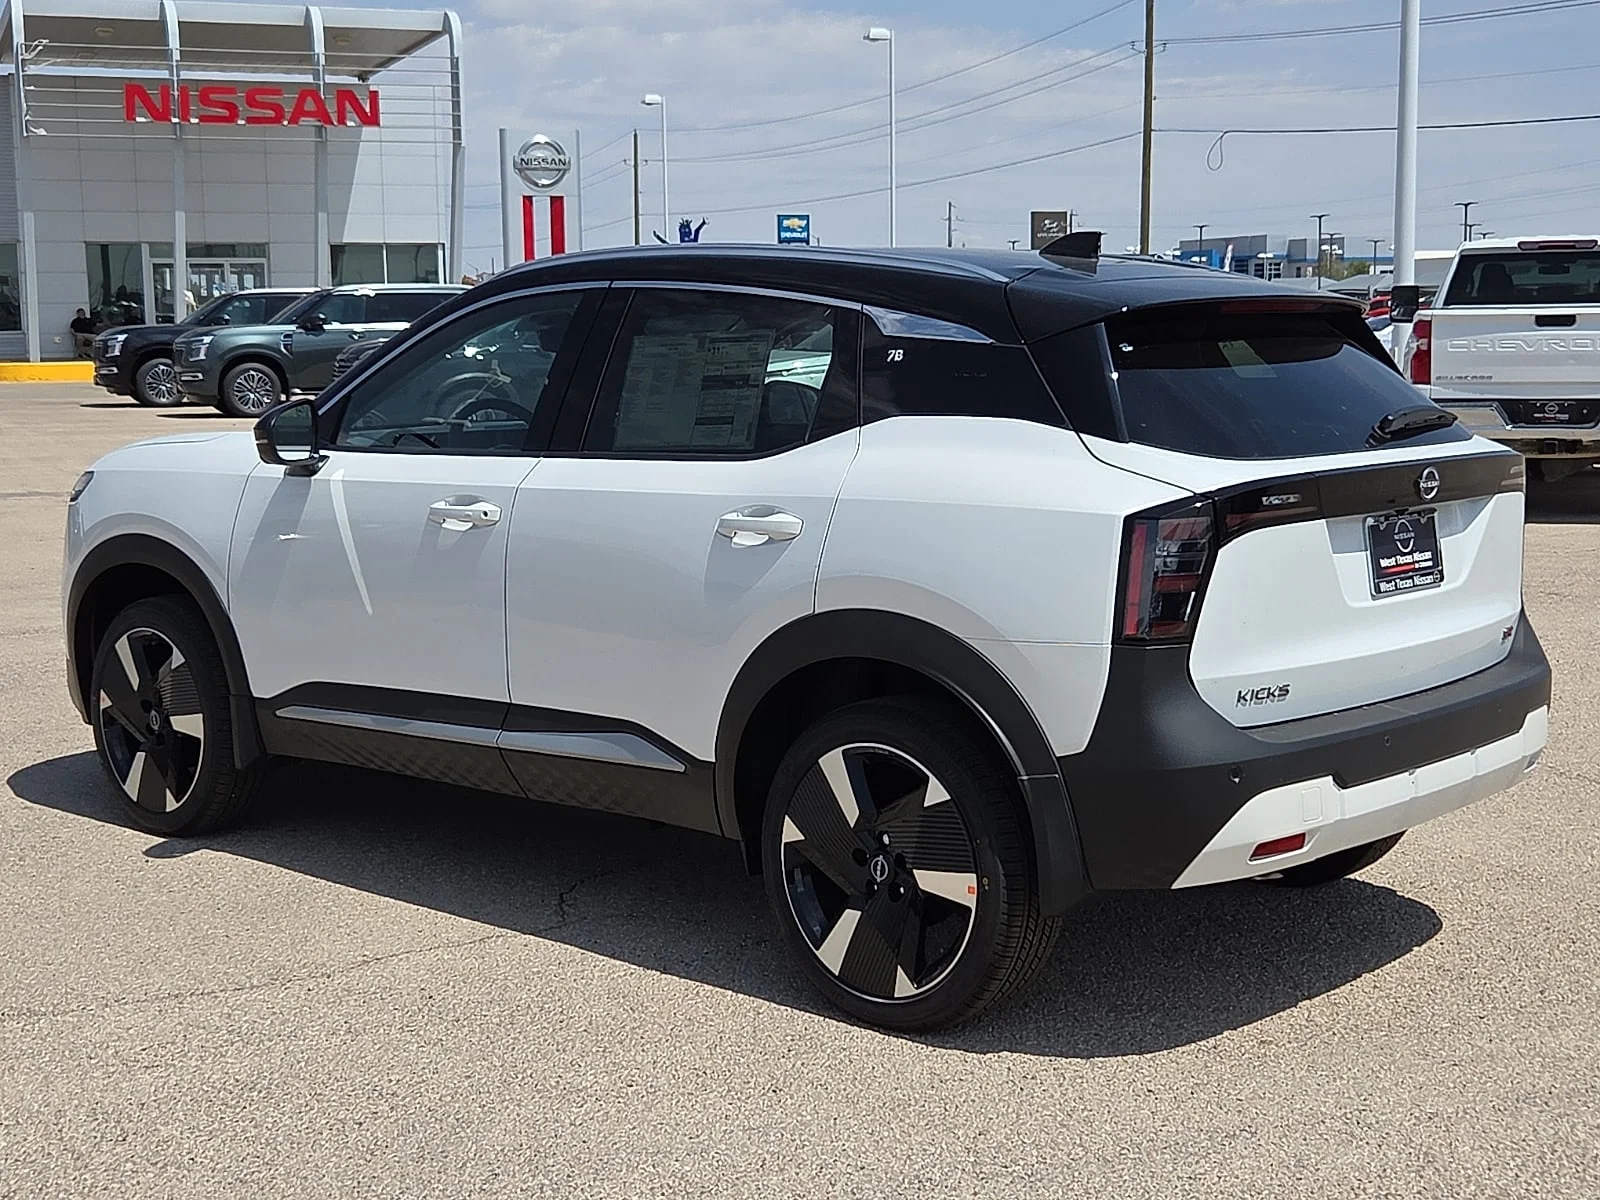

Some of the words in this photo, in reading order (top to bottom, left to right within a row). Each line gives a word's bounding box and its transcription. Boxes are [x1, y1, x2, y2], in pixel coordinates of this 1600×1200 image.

[123, 83, 380, 127] NISSAN
[519, 157, 567, 168] NISSAN
[1447, 337, 1600, 352] CHEVRO
[1379, 556, 1397, 568] West
[1378, 580, 1396, 592] West
[1395, 578, 1413, 589] Texas
[1236, 683, 1291, 704] KICKS
